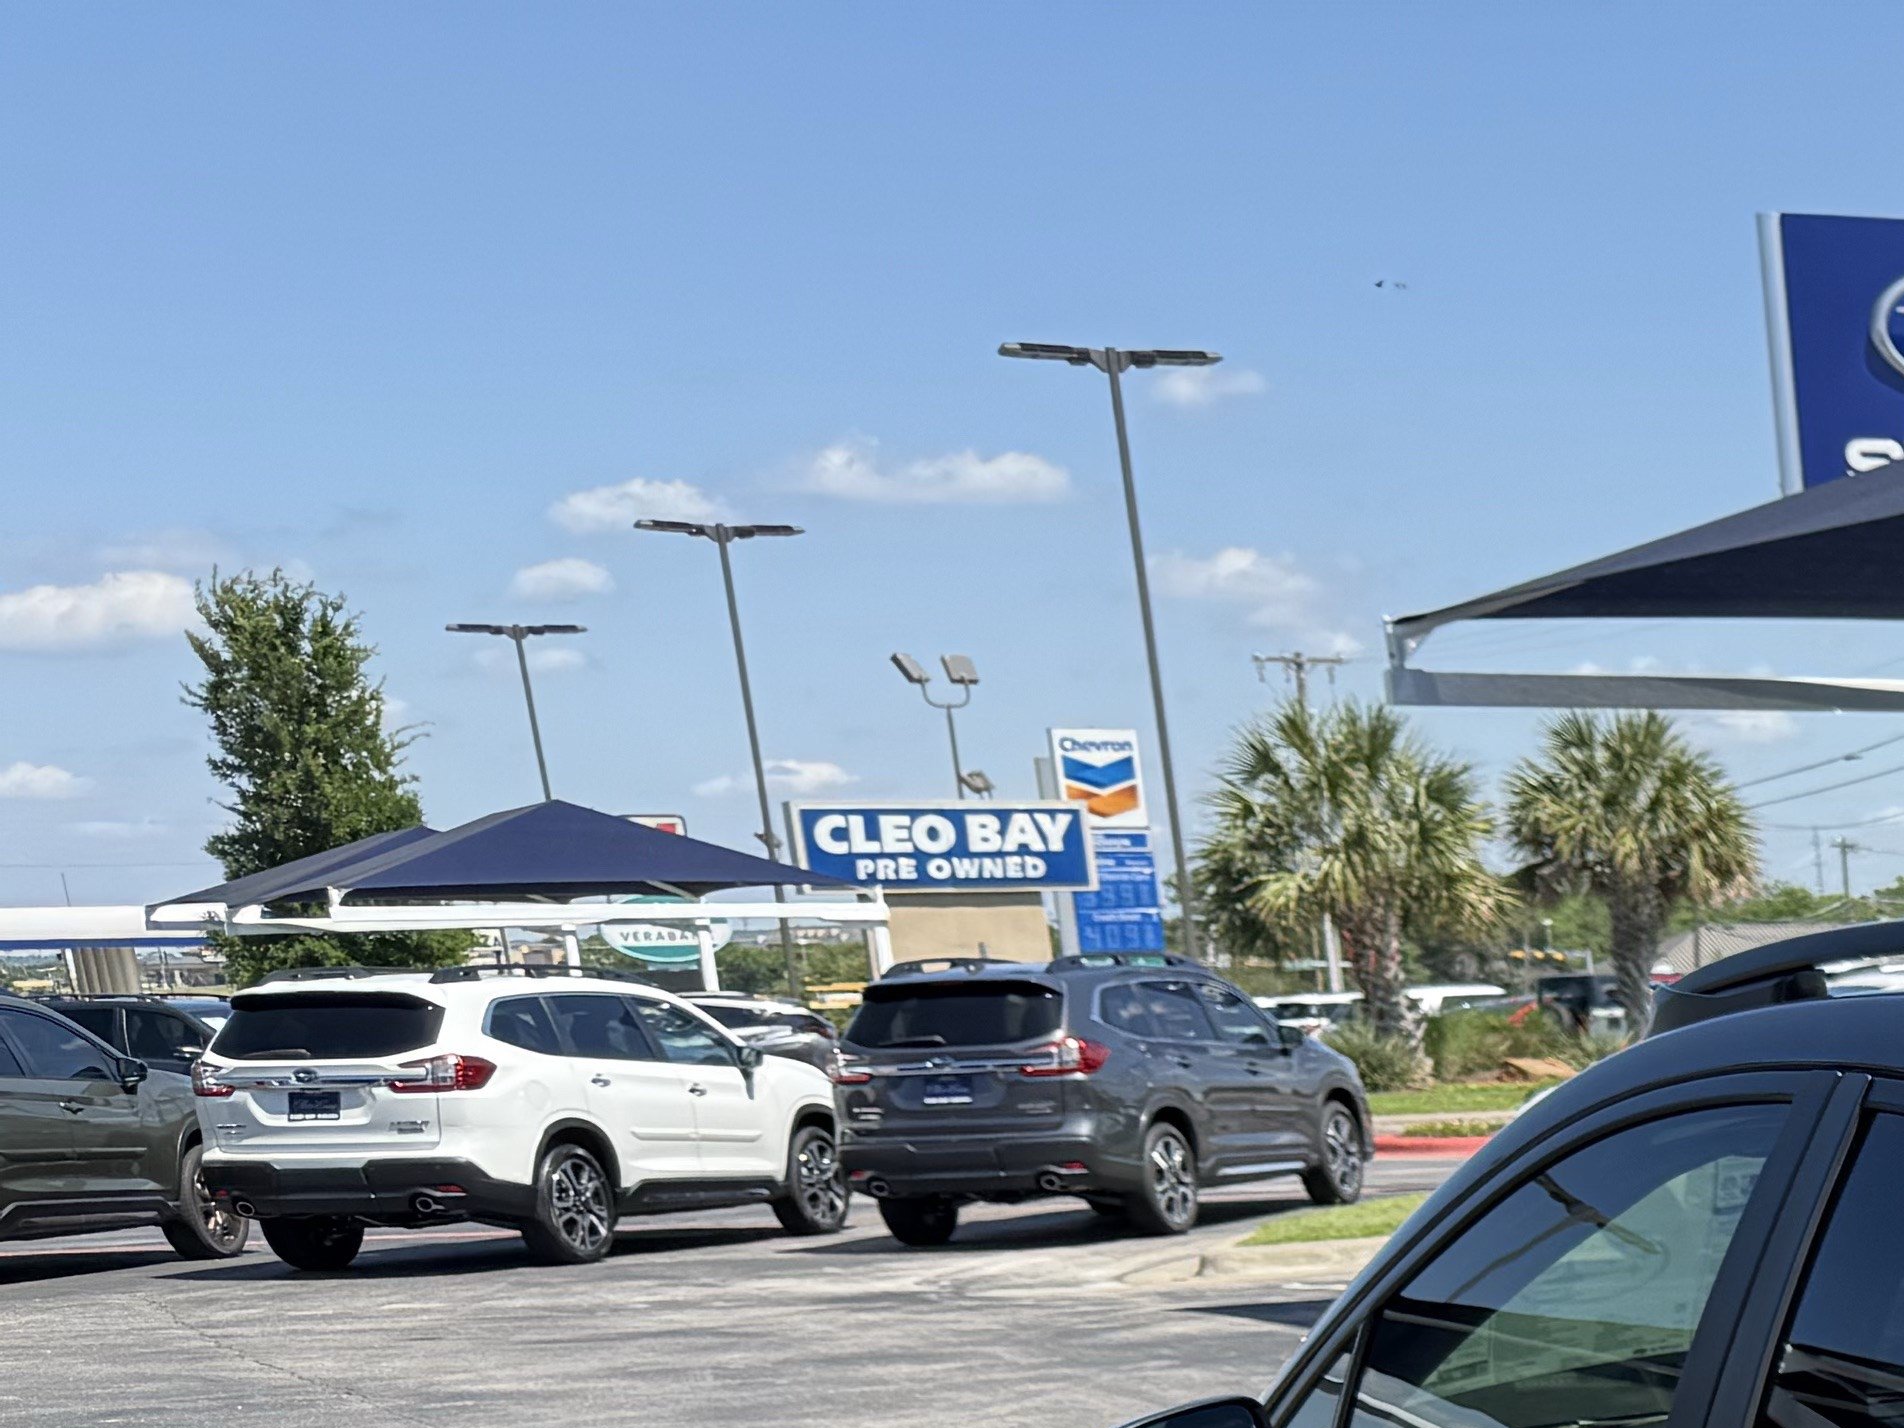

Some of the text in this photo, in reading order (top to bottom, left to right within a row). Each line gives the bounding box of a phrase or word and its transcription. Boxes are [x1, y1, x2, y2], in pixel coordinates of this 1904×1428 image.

[1059, 736, 1133, 753] Chevron
[812, 812, 1073, 854] CLEO BAY
[855, 854, 1048, 881] PRE OWNED
